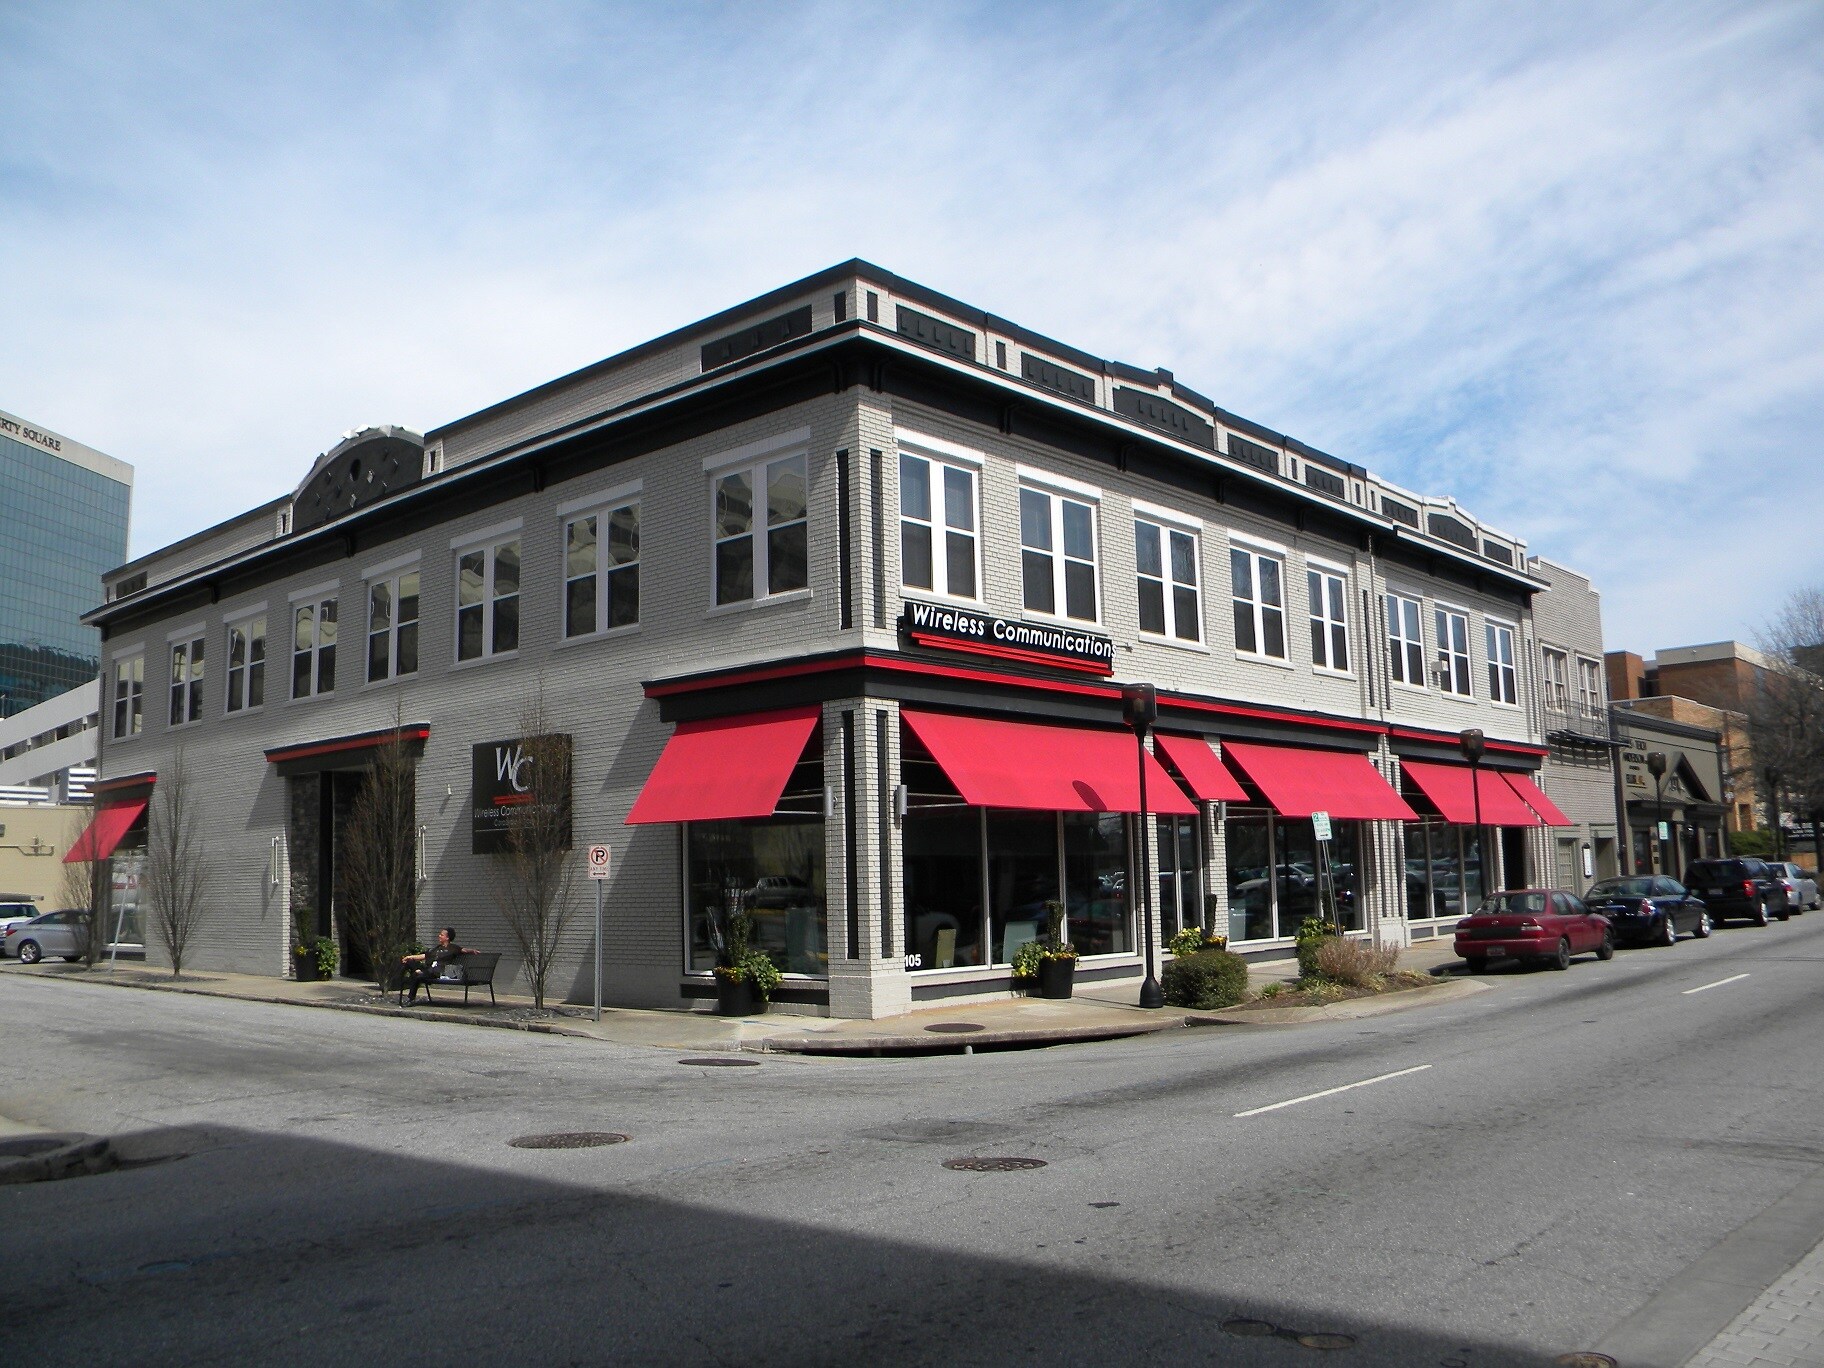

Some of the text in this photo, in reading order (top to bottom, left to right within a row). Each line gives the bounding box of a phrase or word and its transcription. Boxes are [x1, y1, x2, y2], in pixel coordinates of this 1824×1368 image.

[0, 416, 61, 451] RTY SQUARE
[912, 603, 1117, 658] Wireless Communications
[904, 953, 922, 968] 105
